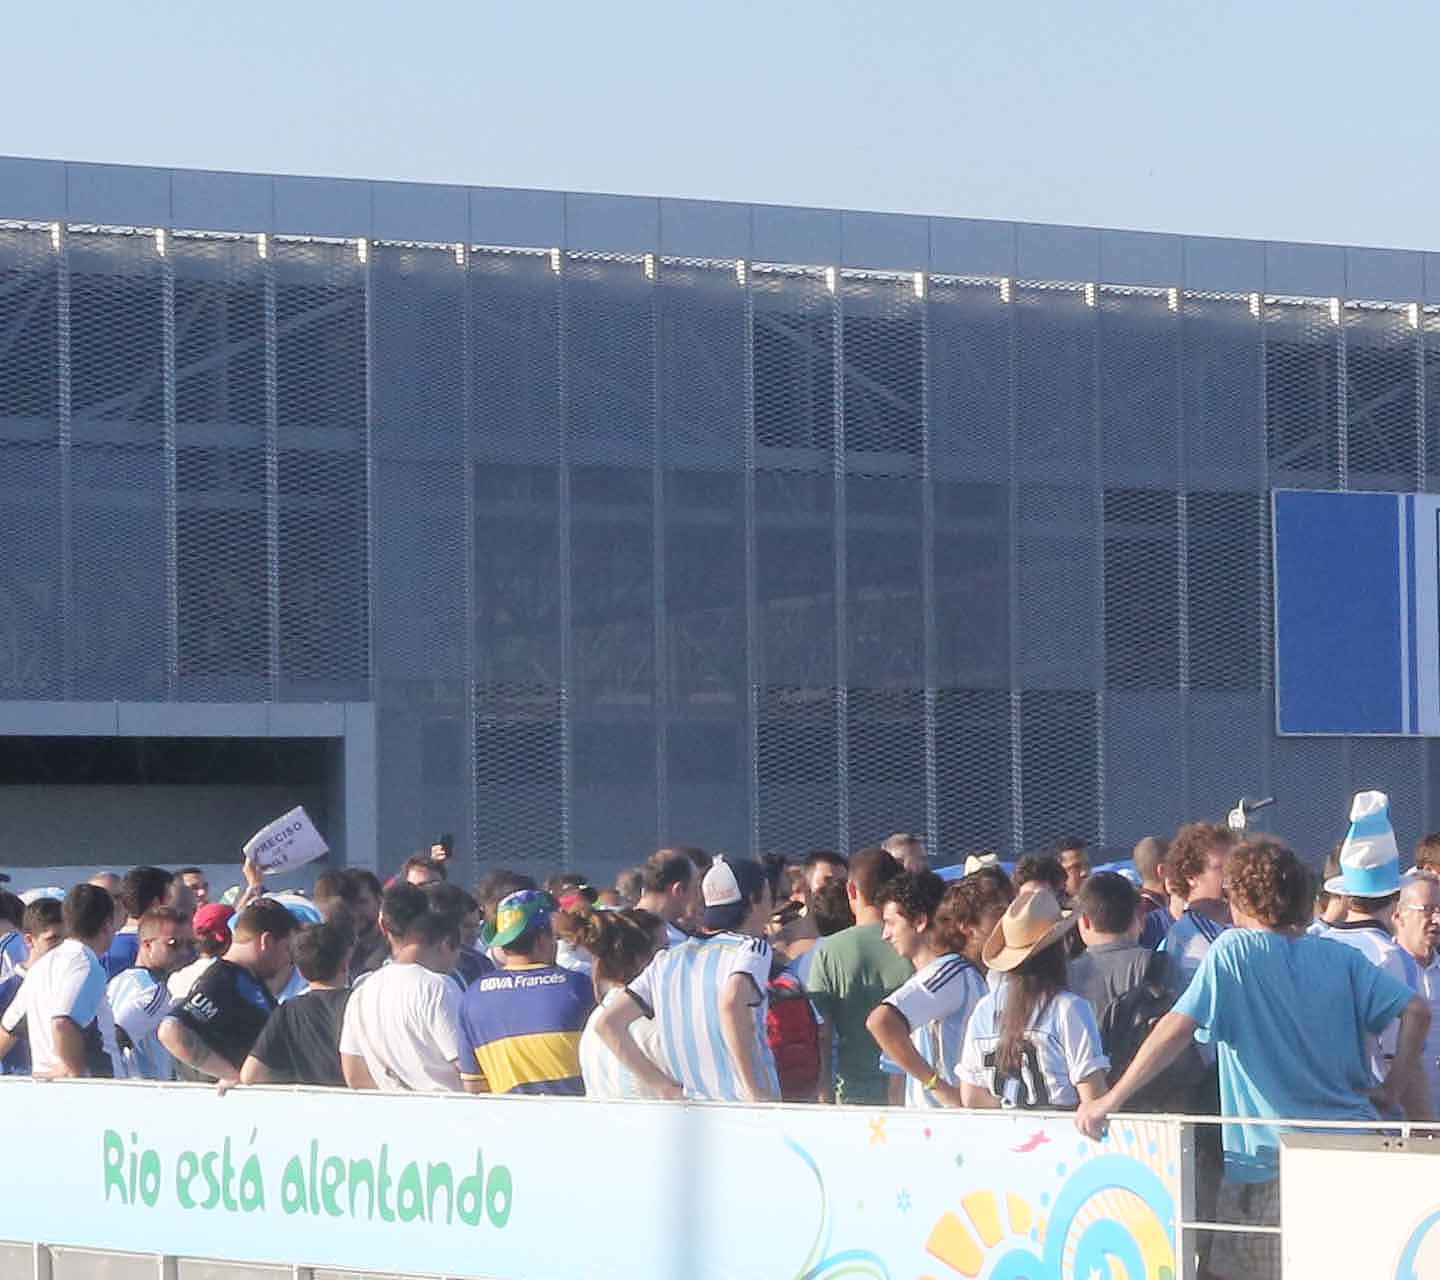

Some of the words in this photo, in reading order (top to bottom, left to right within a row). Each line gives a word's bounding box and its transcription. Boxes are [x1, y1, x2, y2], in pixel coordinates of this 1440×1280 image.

[480, 977, 513, 992] BBVA
[103, 1129, 162, 1207] Rio
[176, 1125, 266, 1212] está
[281, 1138, 513, 1228] alentando
